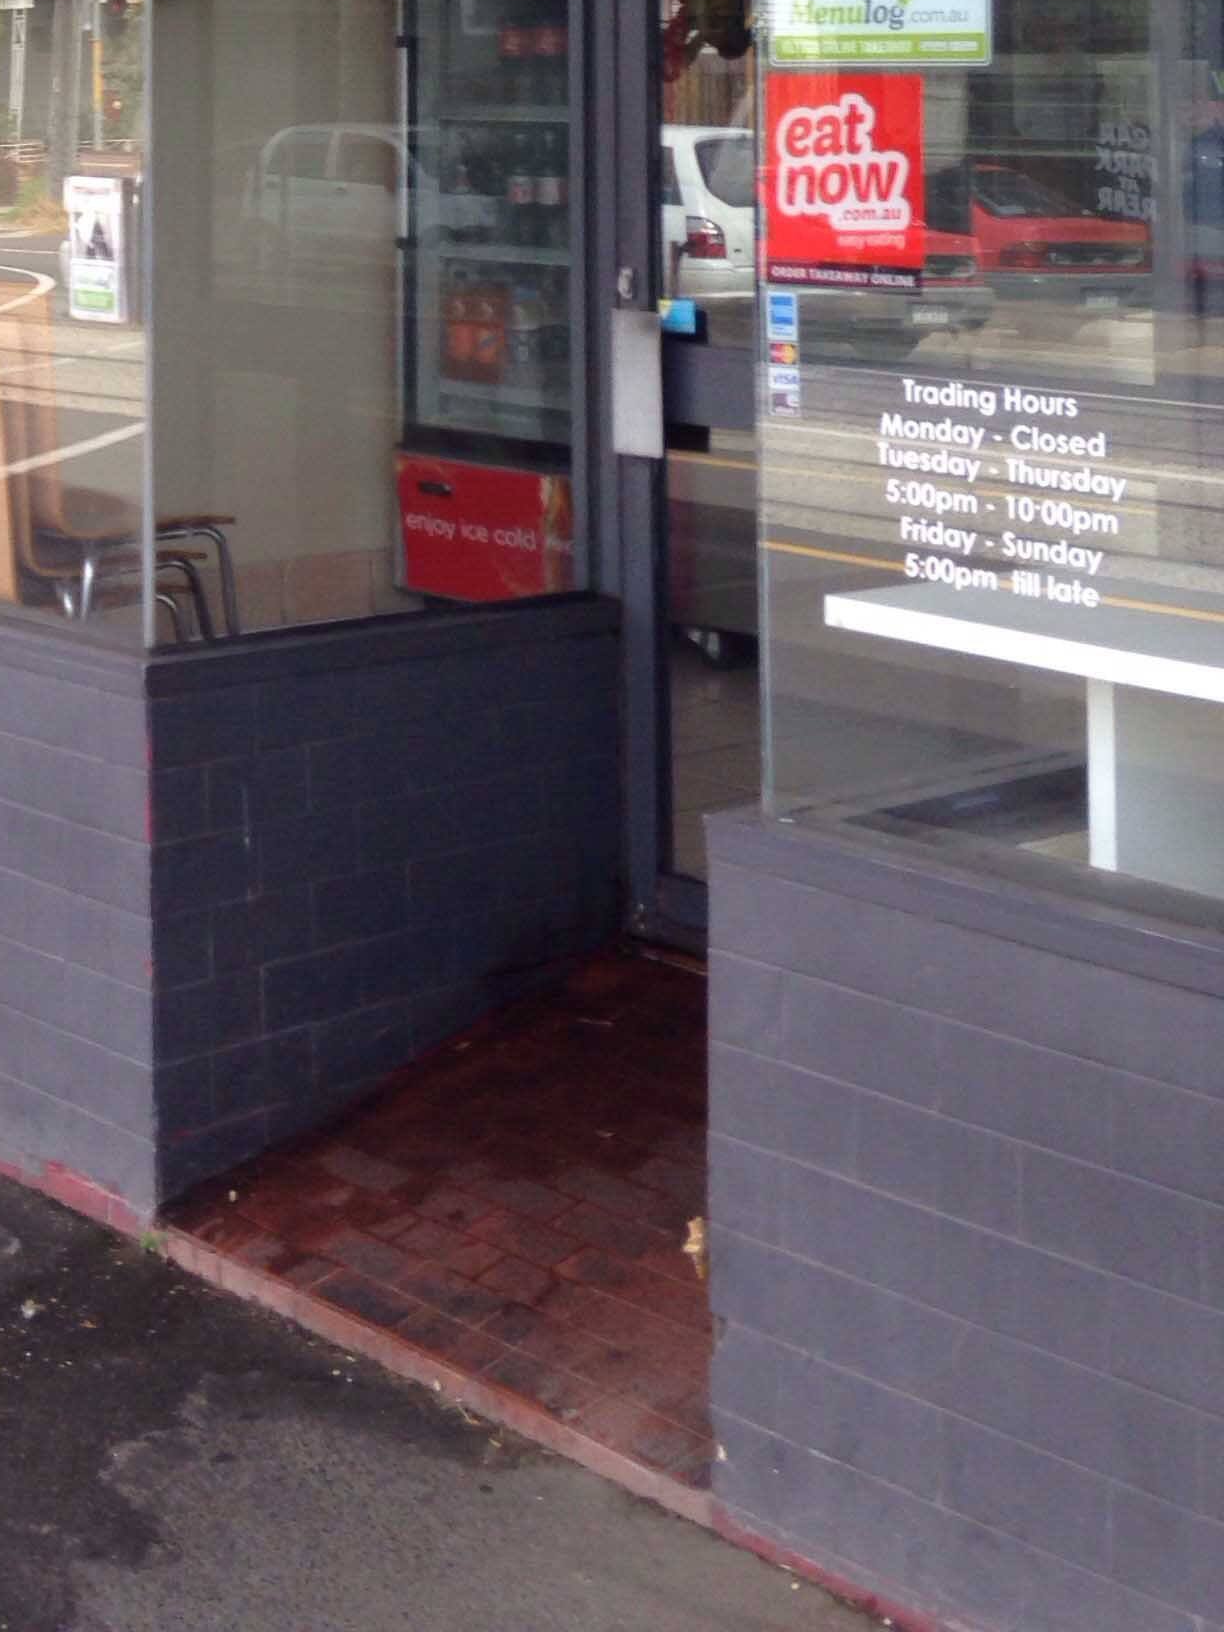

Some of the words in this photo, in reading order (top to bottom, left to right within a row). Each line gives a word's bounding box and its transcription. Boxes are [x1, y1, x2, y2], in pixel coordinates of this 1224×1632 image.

[785, 104, 865, 157] eat
[786, 161, 899, 206] now
[902, 379, 996, 416] Trading
[1004, 388, 1078, 417] Hours
[880, 413, 985, 449] Monday
[1010, 424, 1106, 457] Closed
[877, 442, 981, 482] Tuesday
[1005, 458, 1127, 501] Thursday
[886, 478, 978, 514] 5:00pm
[405, 511, 456, 540] enjoy
[460, 520, 489, 543] ice
[493, 528, 536, 552] cold
[900, 516, 977, 555] Friday
[1001, 531, 1103, 575] Sunday
[904, 553, 998, 590] 5:00pm
[1012, 569, 1040, 598] till
[1047, 576, 1100, 607] late
